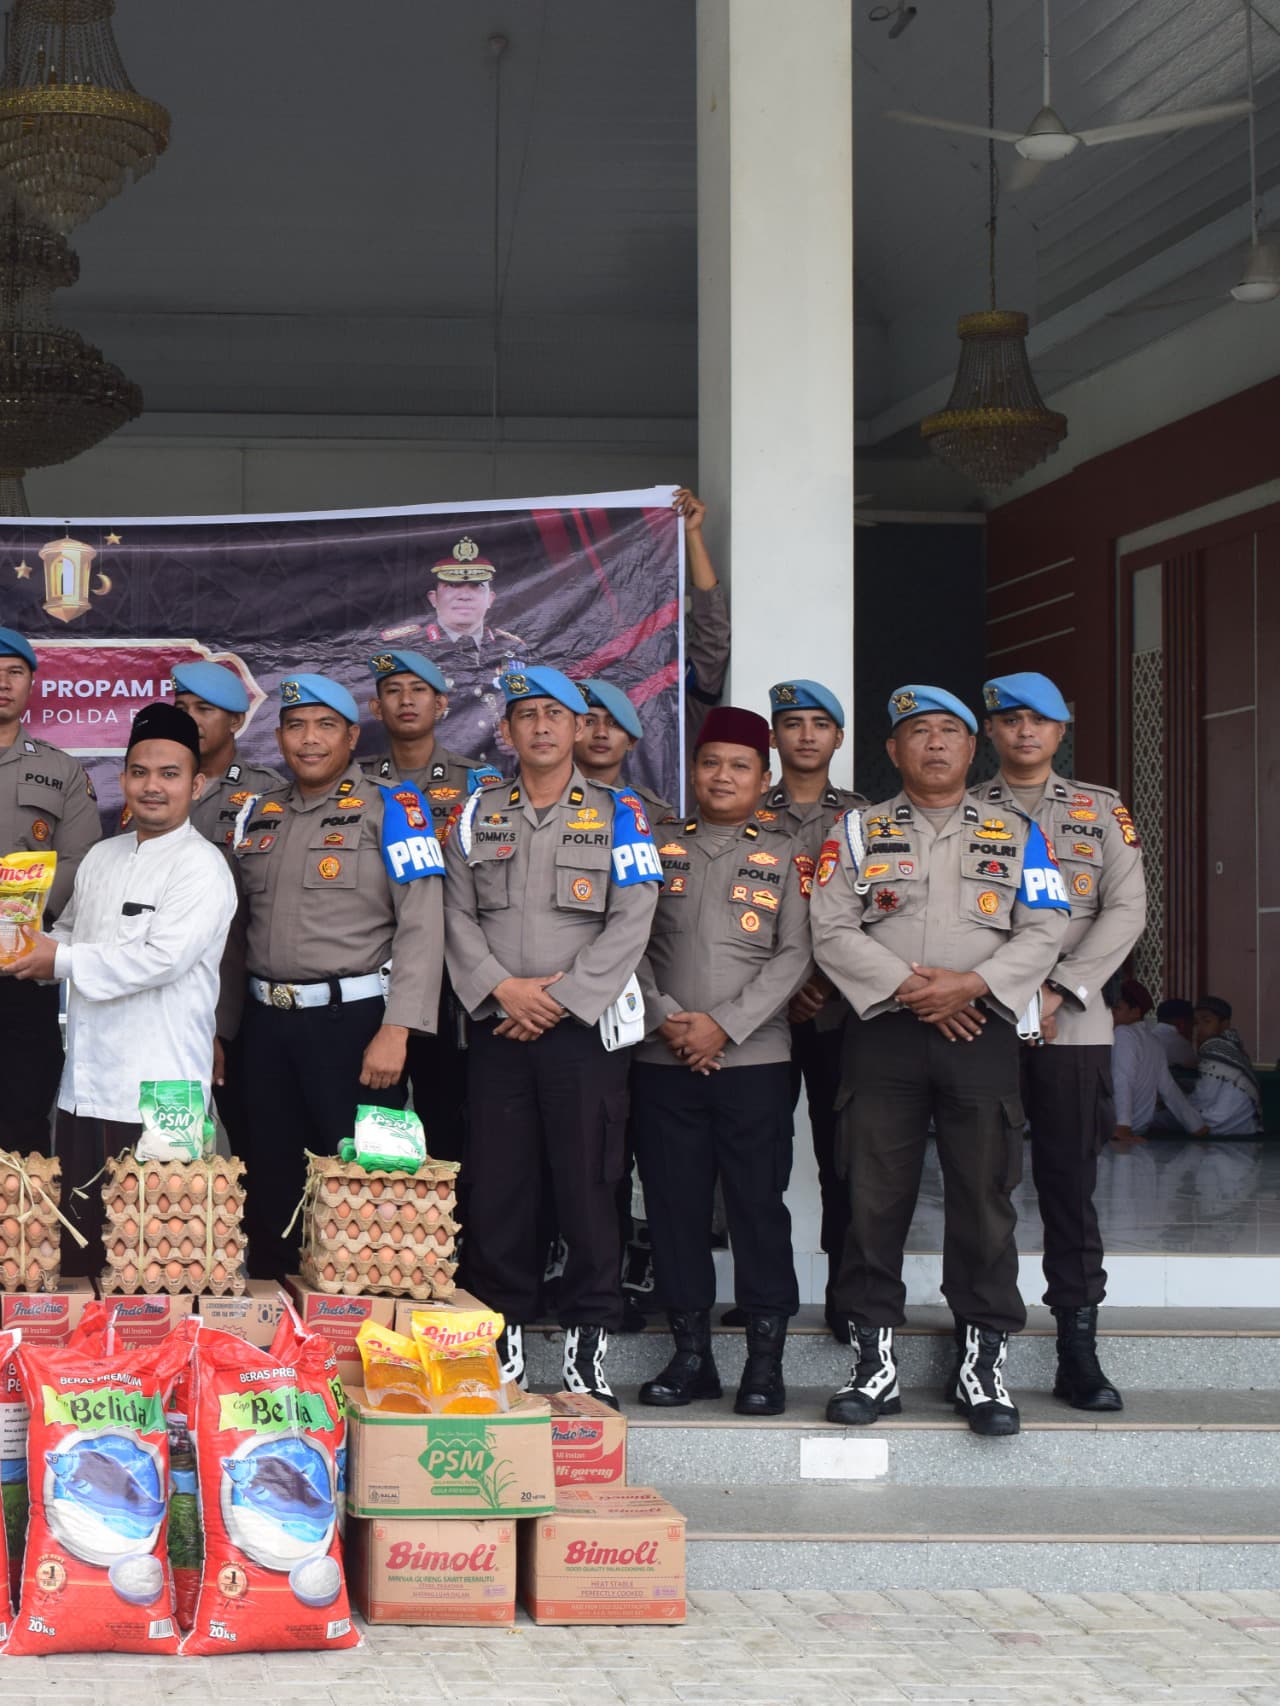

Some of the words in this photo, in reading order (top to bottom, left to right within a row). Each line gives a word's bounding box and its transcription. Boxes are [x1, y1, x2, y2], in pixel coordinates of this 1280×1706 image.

[41, 679, 154, 698] PROPAM
[42, 709, 119, 724] POLDA
[25, 773, 64, 790] POLRI
[321, 815, 362, 828] POLRI
[475, 832, 516, 843] TOMMY.S
[1062, 824, 1104, 839] POLRI
[562, 834, 609, 846] POLRI
[969, 843, 1017, 857] POLRI
[738, 868, 781, 885] POLRI
[158, 1112, 191, 1127] PSM
[97, 1373, 142, 1387] PREMIUM
[239, 1369, 270, 1383] BERAS
[70, 1395, 147, 1428] Belida
[427, 1449, 485, 1472] PSM
[570, 1468, 614, 1479] goreng
[521, 1492, 532, 1500] 20
[385, 1541, 497, 1572] Bimoli
[564, 1540, 659, 1565] Bimoli
